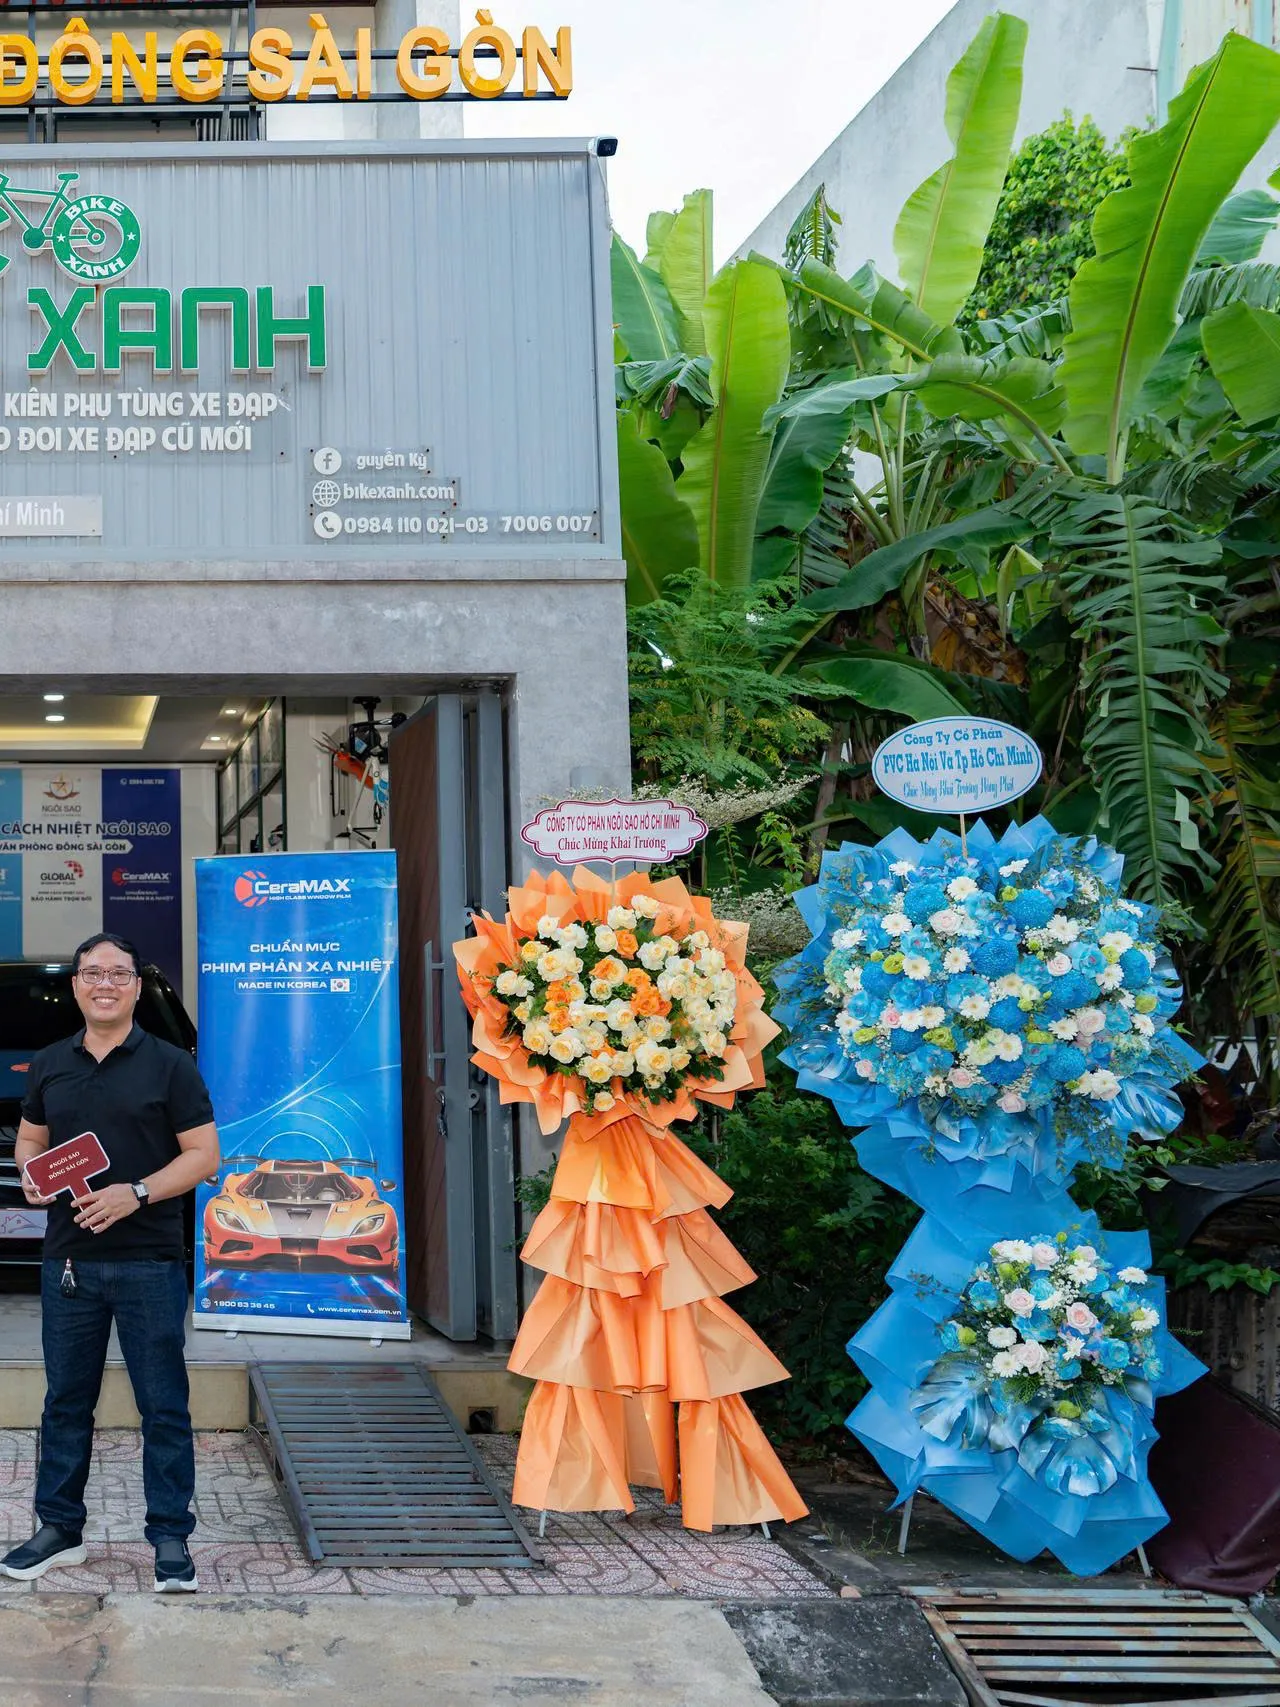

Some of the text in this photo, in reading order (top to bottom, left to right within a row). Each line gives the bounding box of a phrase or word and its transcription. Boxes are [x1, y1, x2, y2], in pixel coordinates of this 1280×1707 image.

[247, 13, 371, 101] SÀI
[396, 8, 573, 99] GÒN
[64, 197, 124, 220] BIKE
[63, 255, 126, 277] XANH
[26, 284, 327, 376] XANH
[118, 387, 183, 417] TÙNG
[189, 393, 220, 417] XE
[227, 393, 277, 421] ĐẠP
[68, 427, 99, 451] XE
[105, 427, 156, 455] ĐẠP
[162, 421, 193, 451] CŨ
[200, 420, 251, 451] MỚI
[343, 484, 454, 500] bikexanh.com
[16, 502, 64, 526] Minh
[344, 517, 393, 533] 0984
[398, 517, 421, 533] 110
[502, 515, 552, 532] 7006
[557, 515, 592, 532] 007
[904, 734, 933, 746] Công
[936, 731, 950, 745] Ty
[883, 754, 903, 773] PVC
[905, 752, 920, 772] Hà
[955, 750, 968, 774] Tp
[1006, 745, 1033, 765] Minh
[63, 805, 81, 813] SAO
[546, 813, 565, 832] CÔNG
[567, 816, 575, 831] TY
[607, 811, 623, 830] NGÔI
[625, 814, 638, 830] SAO
[651, 810, 663, 829] CHÍ
[664, 814, 680, 829] MINH
[1, 821, 42, 835] CÁCH
[46, 821, 92, 839] NHIỆT
[96, 820, 136, 836] NGÔI
[138, 821, 172, 836] SAO
[19, 841, 54, 851] PHÒNG
[56, 841, 84, 851] ĐÔNG
[87, 841, 102, 851] SÀI
[105, 841, 126, 851] GÒN
[558, 836, 666, 852] Chúc Mừng Khai Trương
[40, 872, 76, 881] GLOBAL
[122, 872, 169, 880] CeraMAX
[255, 879, 350, 894] CeraMAX
[250, 939, 340, 955] CHUẨN MỰC
[202, 958, 393, 975] PHIM PHẢN XẠ NHIỆT
[289, 981, 327, 989] KOREA
[68, 1151, 80, 1160] SAO
[318, 1305, 401, 1316] www.ceramax.com.vn
